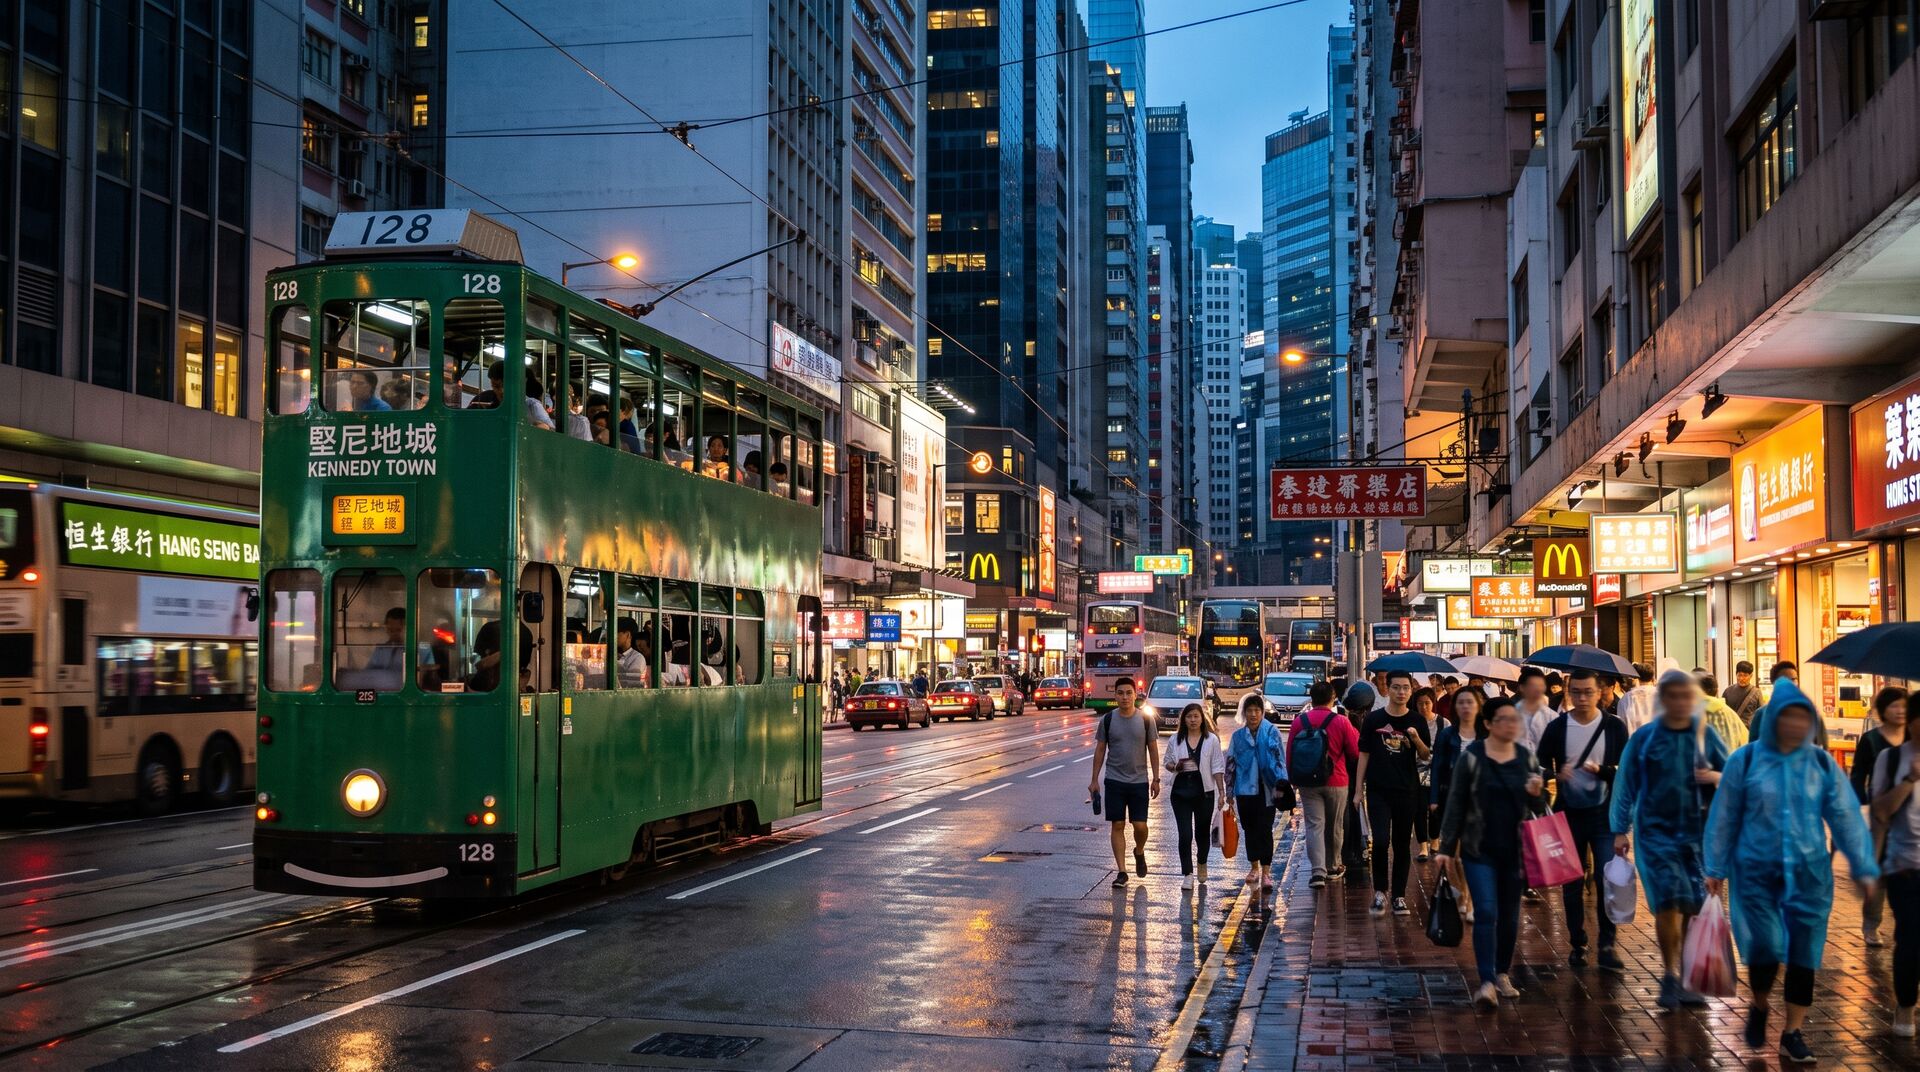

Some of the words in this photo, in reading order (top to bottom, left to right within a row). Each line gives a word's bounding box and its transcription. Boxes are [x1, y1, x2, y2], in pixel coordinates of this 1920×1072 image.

[360, 213, 432, 245] 128
[273, 281, 298, 301] 128
[462, 273, 501, 294] 128
[309, 422, 437, 457] 堅尼地城
[308, 459, 382, 478] KENNEDY
[385, 459, 437, 476] TOWN
[338, 498, 401, 514] 堅尼地城
[65, 520, 153, 558] 恒生銀行
[159, 534, 201, 558] HANG
[203, 539, 240, 562] SENG
[1537, 582, 1588, 593] McDonald's
[459, 843, 495, 862] 128
